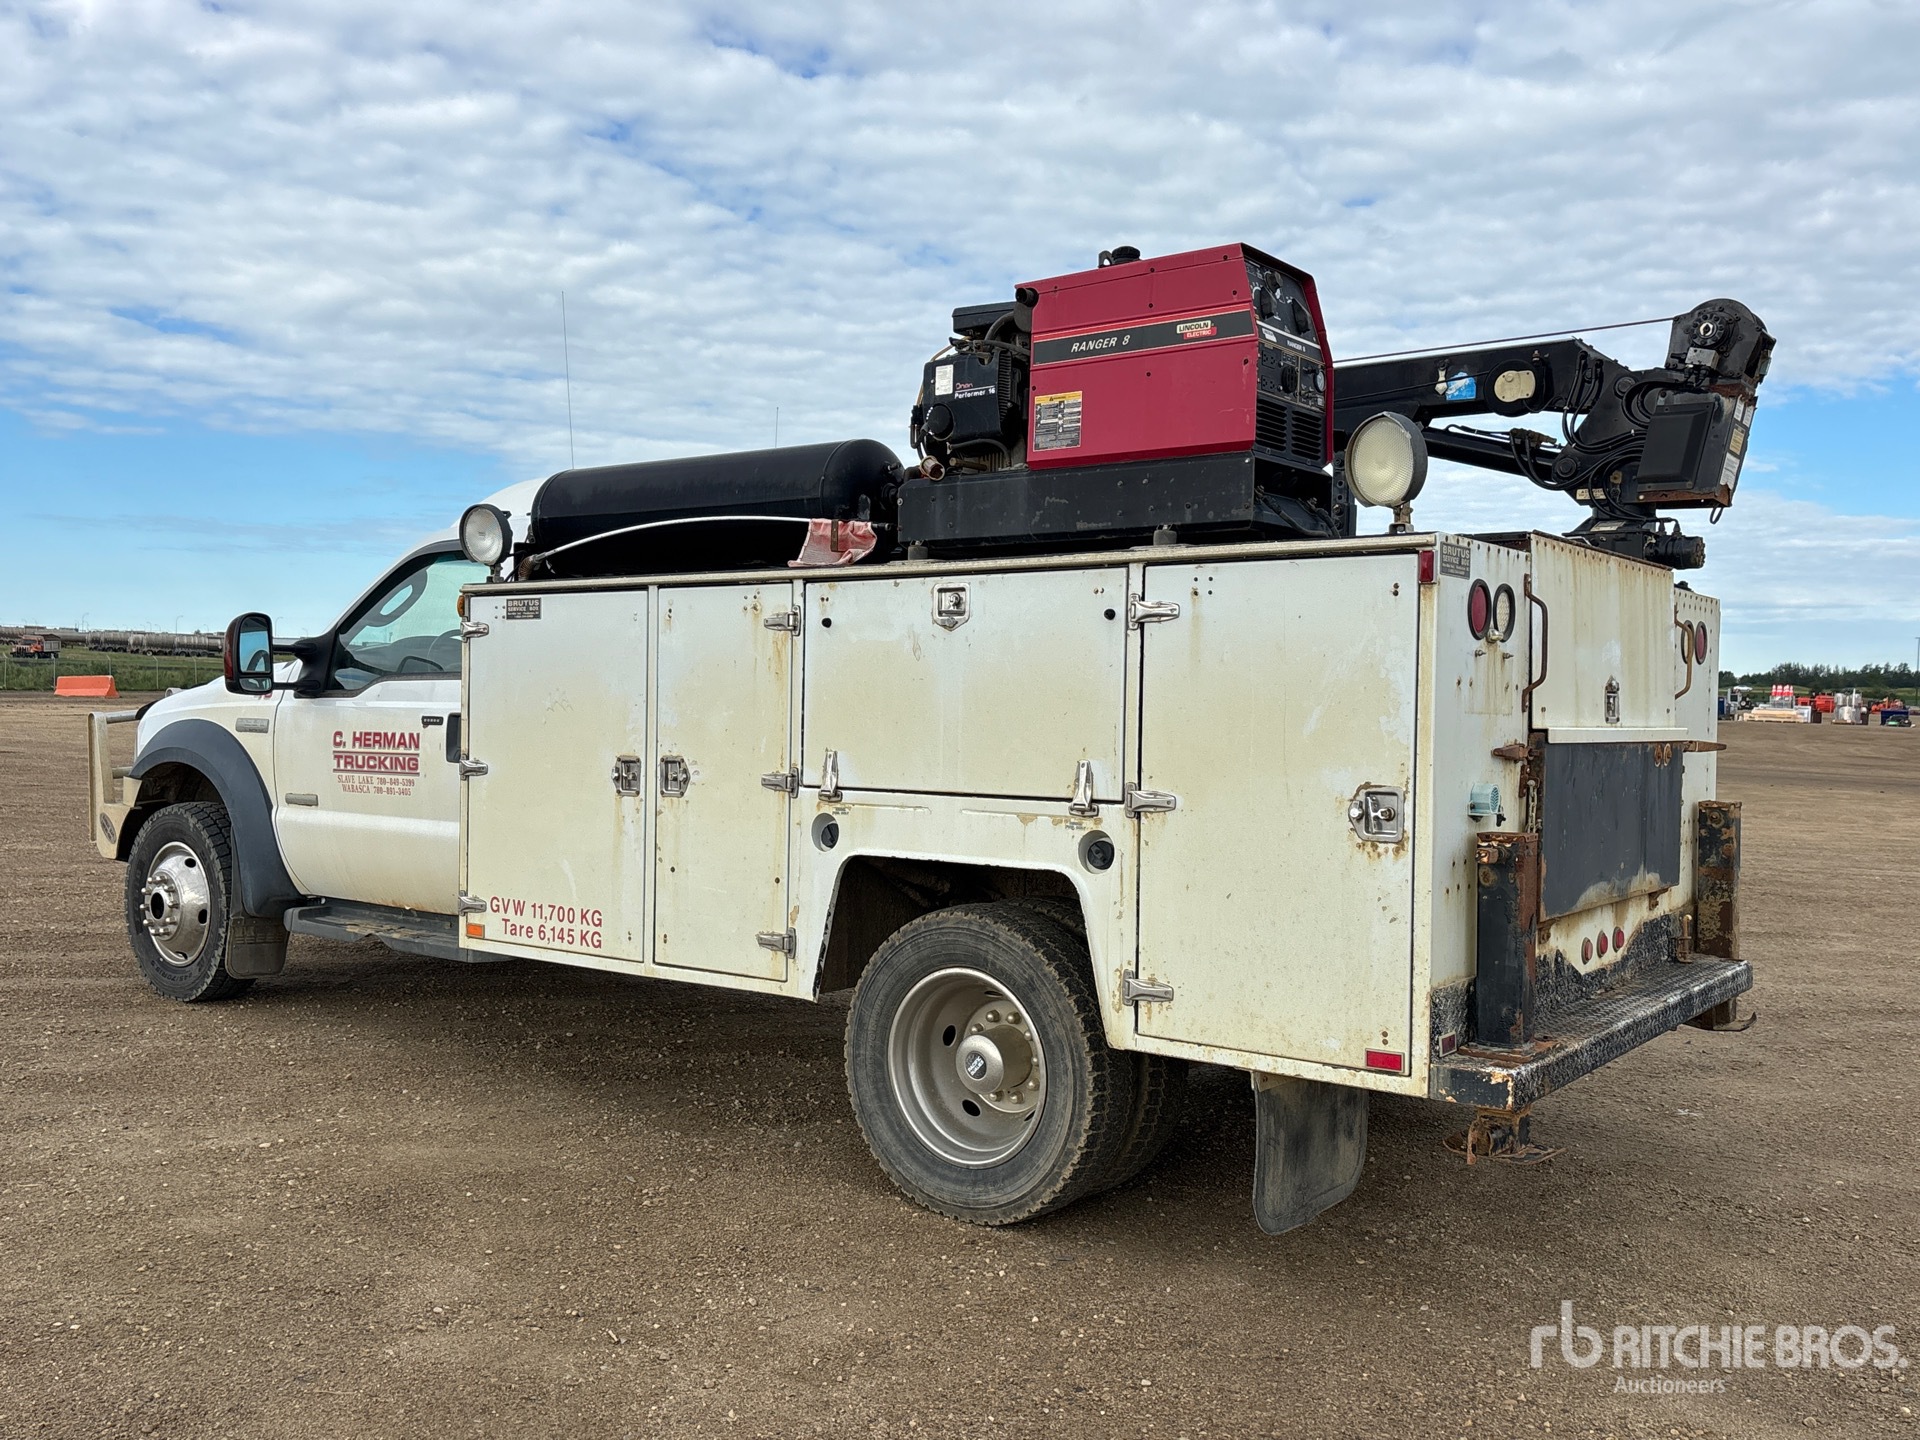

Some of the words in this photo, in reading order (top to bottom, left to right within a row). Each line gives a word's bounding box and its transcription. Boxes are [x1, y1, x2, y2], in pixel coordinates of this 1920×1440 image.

[1178, 322, 1209, 332] LINCOLN
[1186, 329, 1212, 338] ELECTRIC
[1071, 336, 1117, 353] RANGER
[1122, 335, 1131, 346] 8
[954, 389, 986, 400] Performer
[1442, 545, 1469, 558] BRUTUS
[1442, 555, 1459, 564] SERVICE
[333, 730, 346, 749] C.
[351, 731, 420, 750] HERMAN
[333, 754, 419, 772] TRUCKING
[337, 774, 356, 784] SLAVE
[358, 775, 374, 785] LAKE
[341, 784, 371, 794] WABASCA
[490, 896, 526, 917] GVW
[531, 902, 575, 924] 11,700
[580, 908, 603, 928] KG
[501, 918, 534, 939] Tare
[538, 924, 575, 945] 6,145
[580, 929, 602, 949] KG
